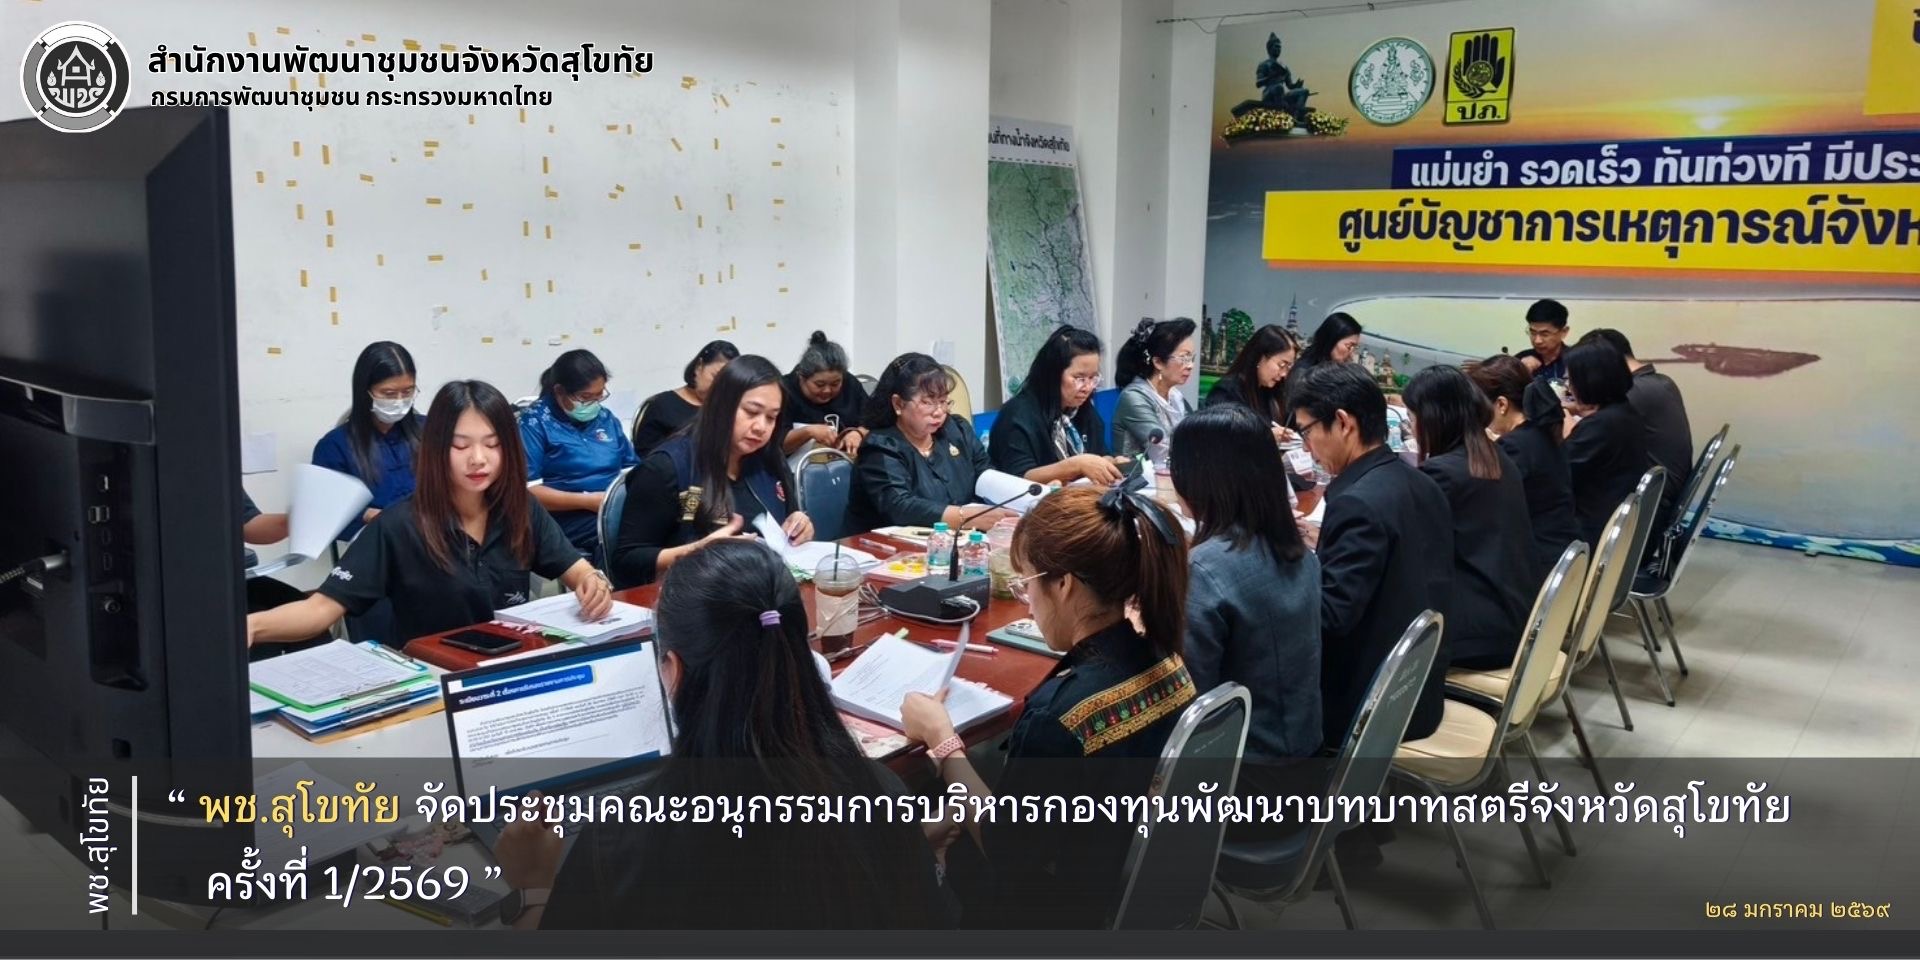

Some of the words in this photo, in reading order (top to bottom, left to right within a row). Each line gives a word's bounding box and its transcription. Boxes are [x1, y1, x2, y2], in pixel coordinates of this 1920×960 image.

[1456, 103, 1501, 120] ปภ.
[1410, 149, 1509, 187] แม่นยำ
[1519, 143, 1642, 186] รวดเร็ว
[1653, 141, 1812, 184] ทันท่วงที
